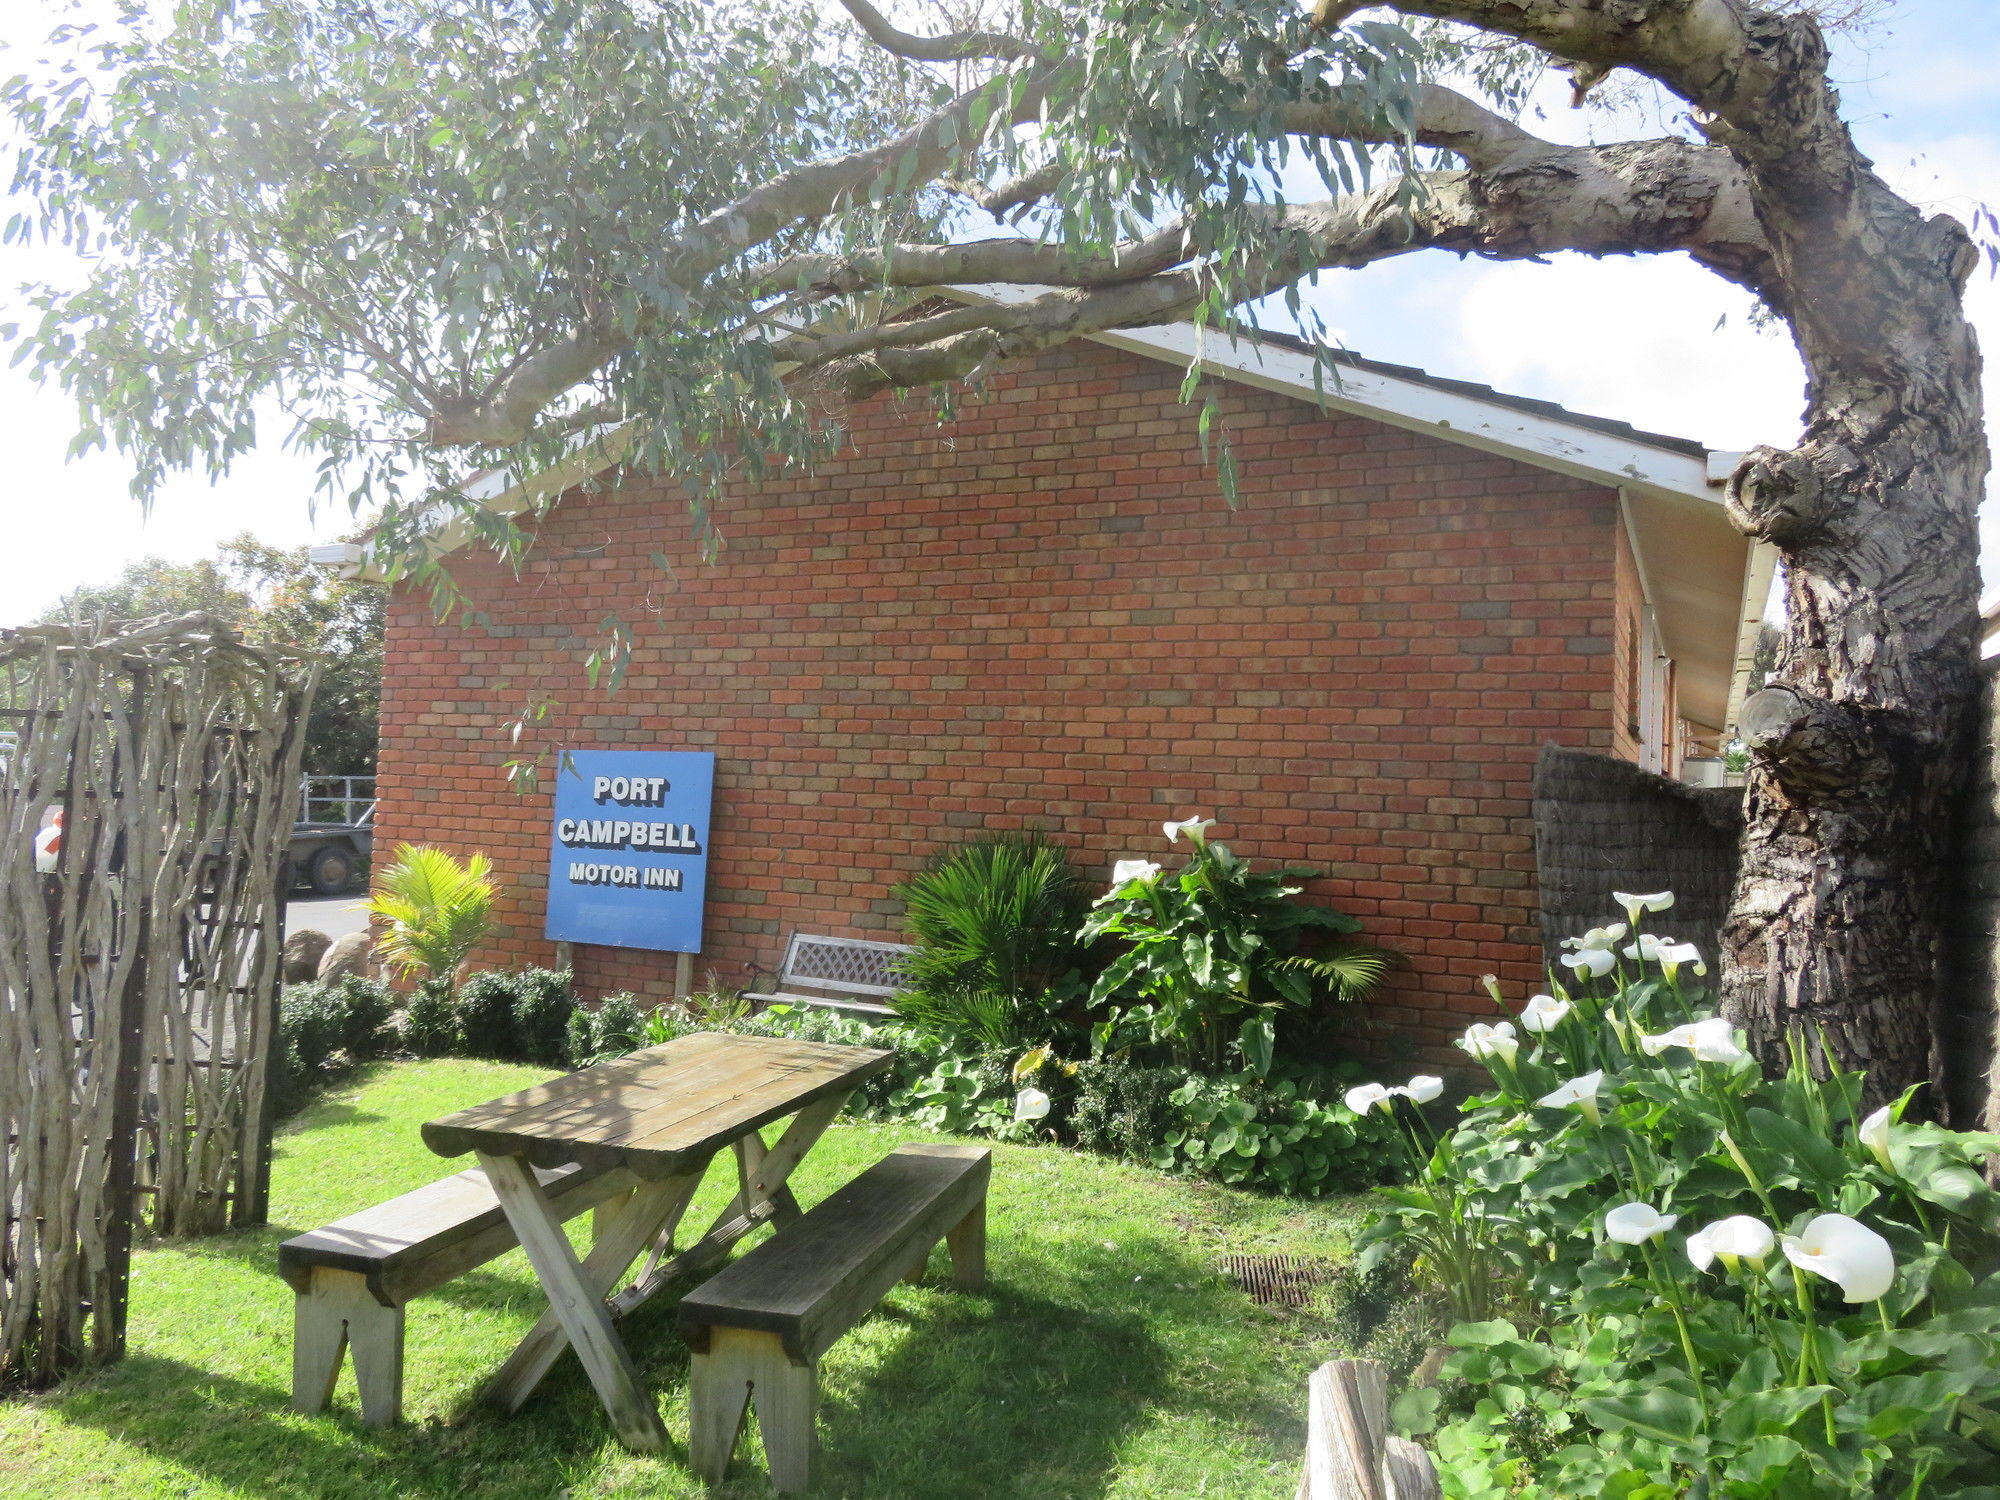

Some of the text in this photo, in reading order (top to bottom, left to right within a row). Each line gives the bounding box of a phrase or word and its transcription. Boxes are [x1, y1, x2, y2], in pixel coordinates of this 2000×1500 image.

[593, 776, 667, 804] PORT
[557, 818, 699, 850] CAMPBELL
[569, 862, 681, 889] MOTOR INN
